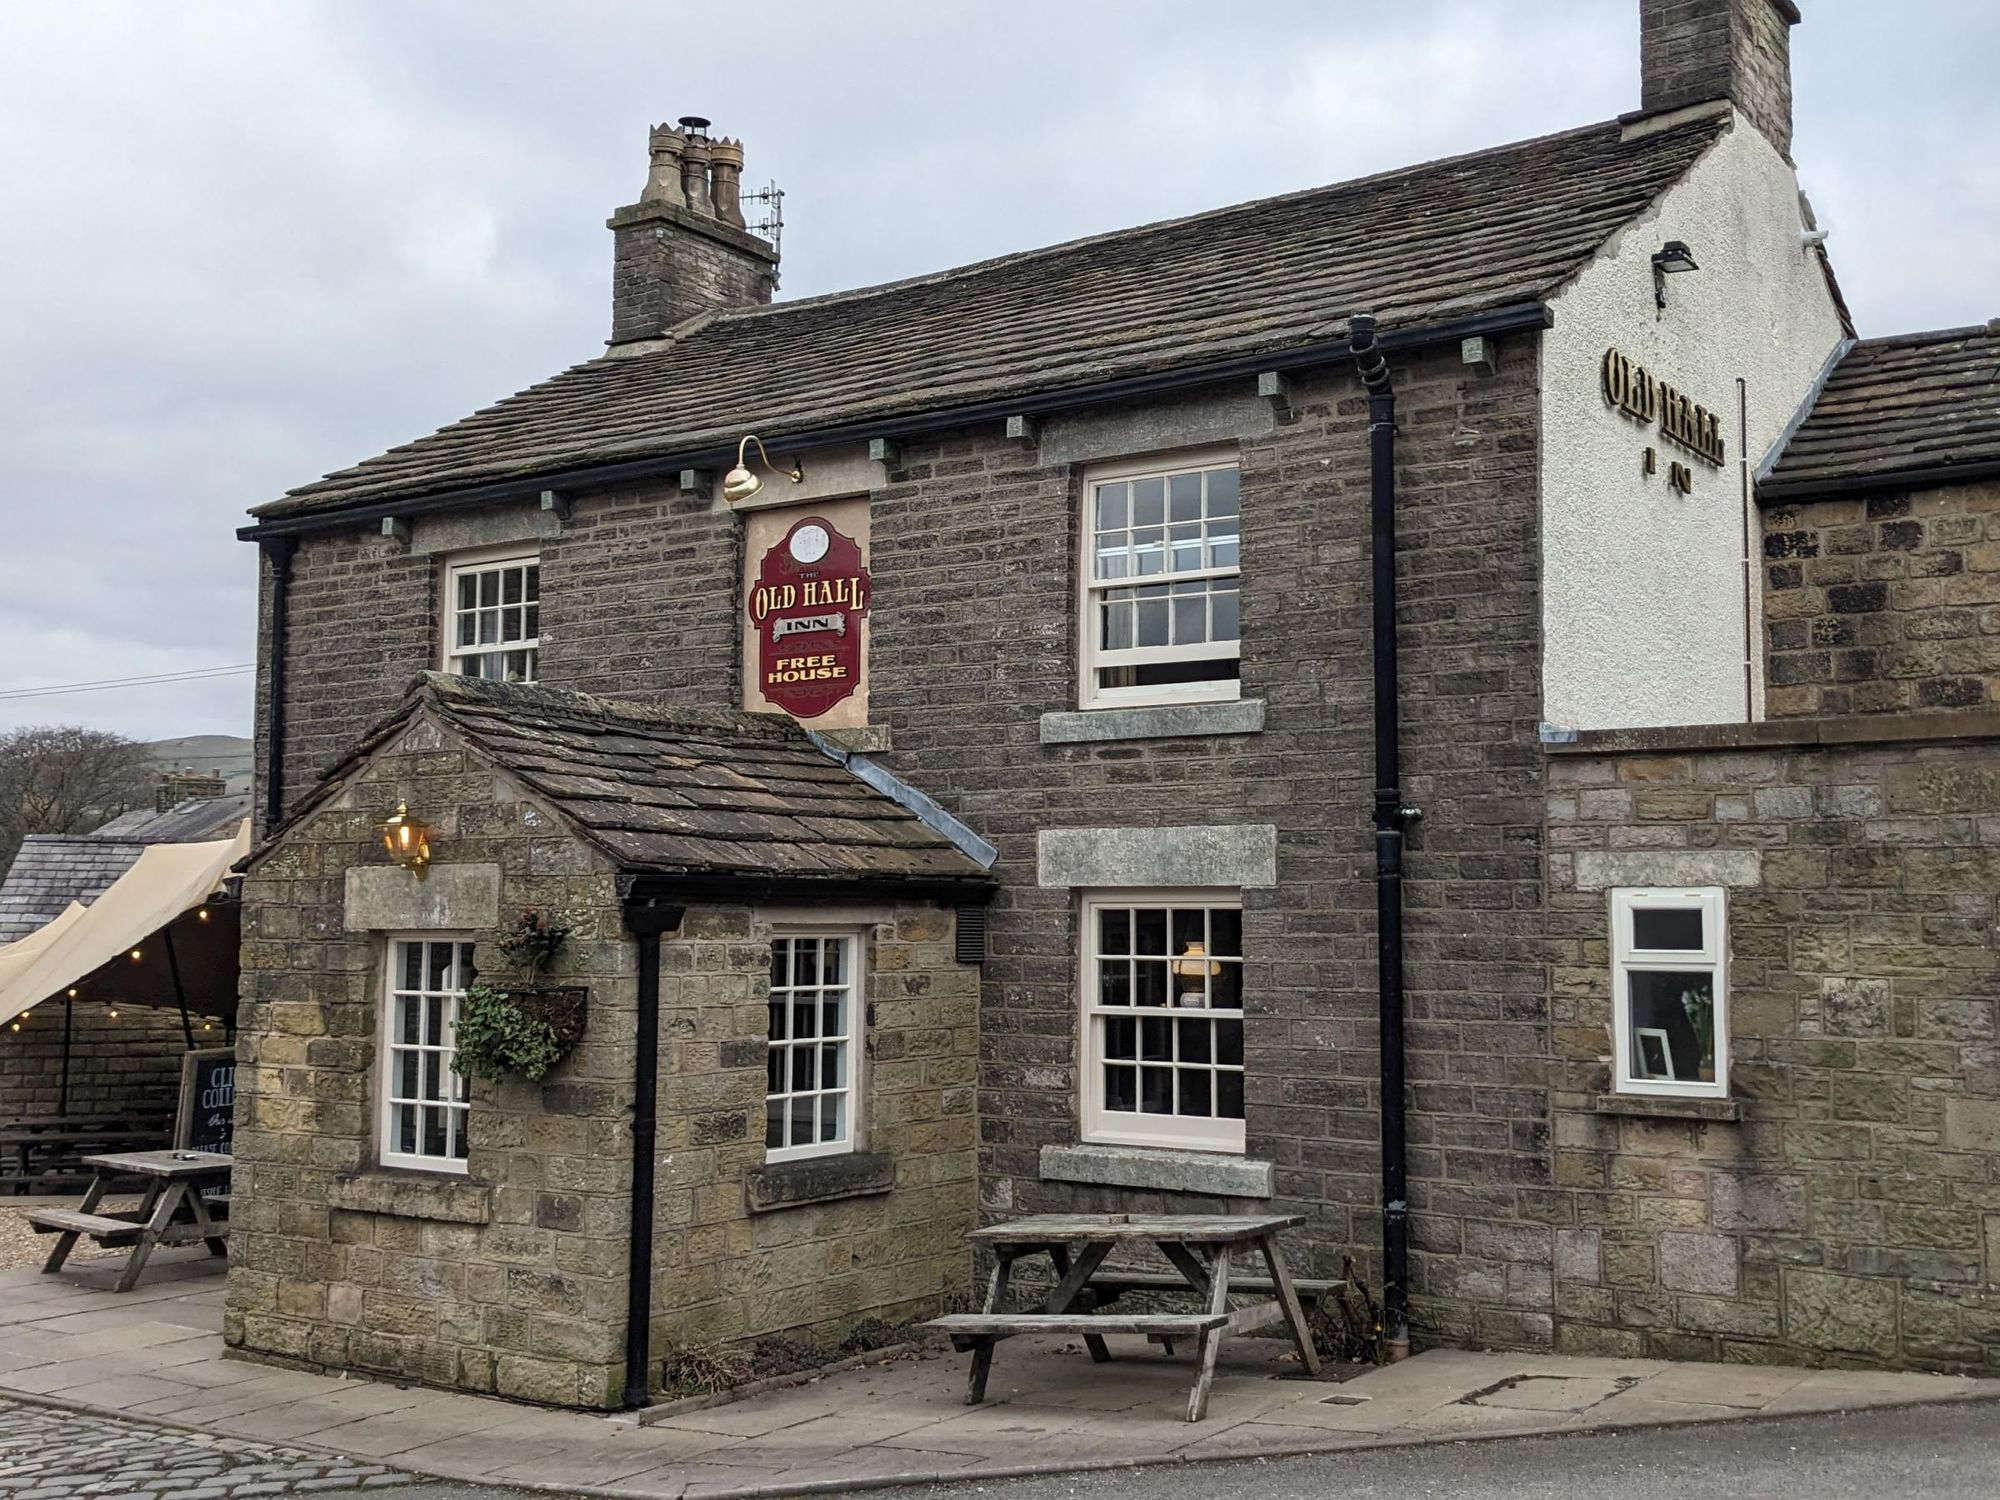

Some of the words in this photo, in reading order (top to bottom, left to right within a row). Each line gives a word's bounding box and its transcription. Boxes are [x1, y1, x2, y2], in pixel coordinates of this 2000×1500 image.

[1604, 347, 1657, 423] OLD
[1660, 381, 1725, 467] HALL
[755, 584, 796, 620] OLD
[802, 576, 864, 611] HALL
[786, 617, 829, 632] INN
[776, 654, 837, 671] FREE
[768, 666, 847, 684] HOUSE
[211, 1067, 234, 1088] CLI
[202, 1088, 236, 1109] COLL
